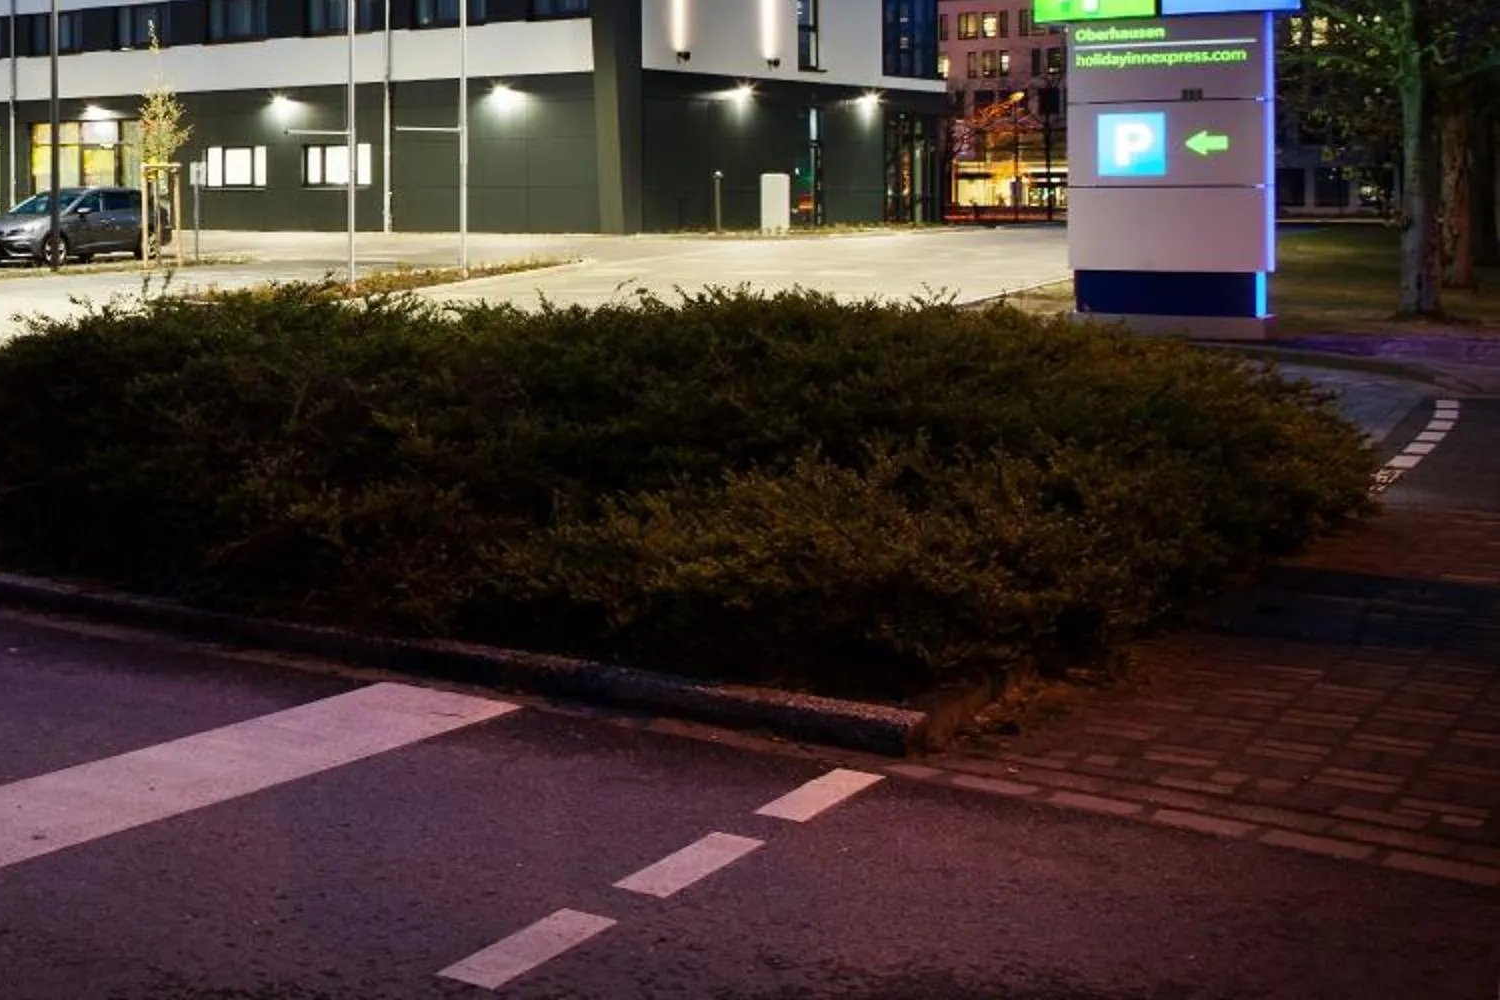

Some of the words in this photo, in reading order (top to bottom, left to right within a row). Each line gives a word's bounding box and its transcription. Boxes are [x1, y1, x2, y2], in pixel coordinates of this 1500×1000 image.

[1075, 26, 1165, 42] Oberhausen
[1075, 50, 1248, 69] holidayinnexpress.com
[1116, 124, 1153, 167] P
